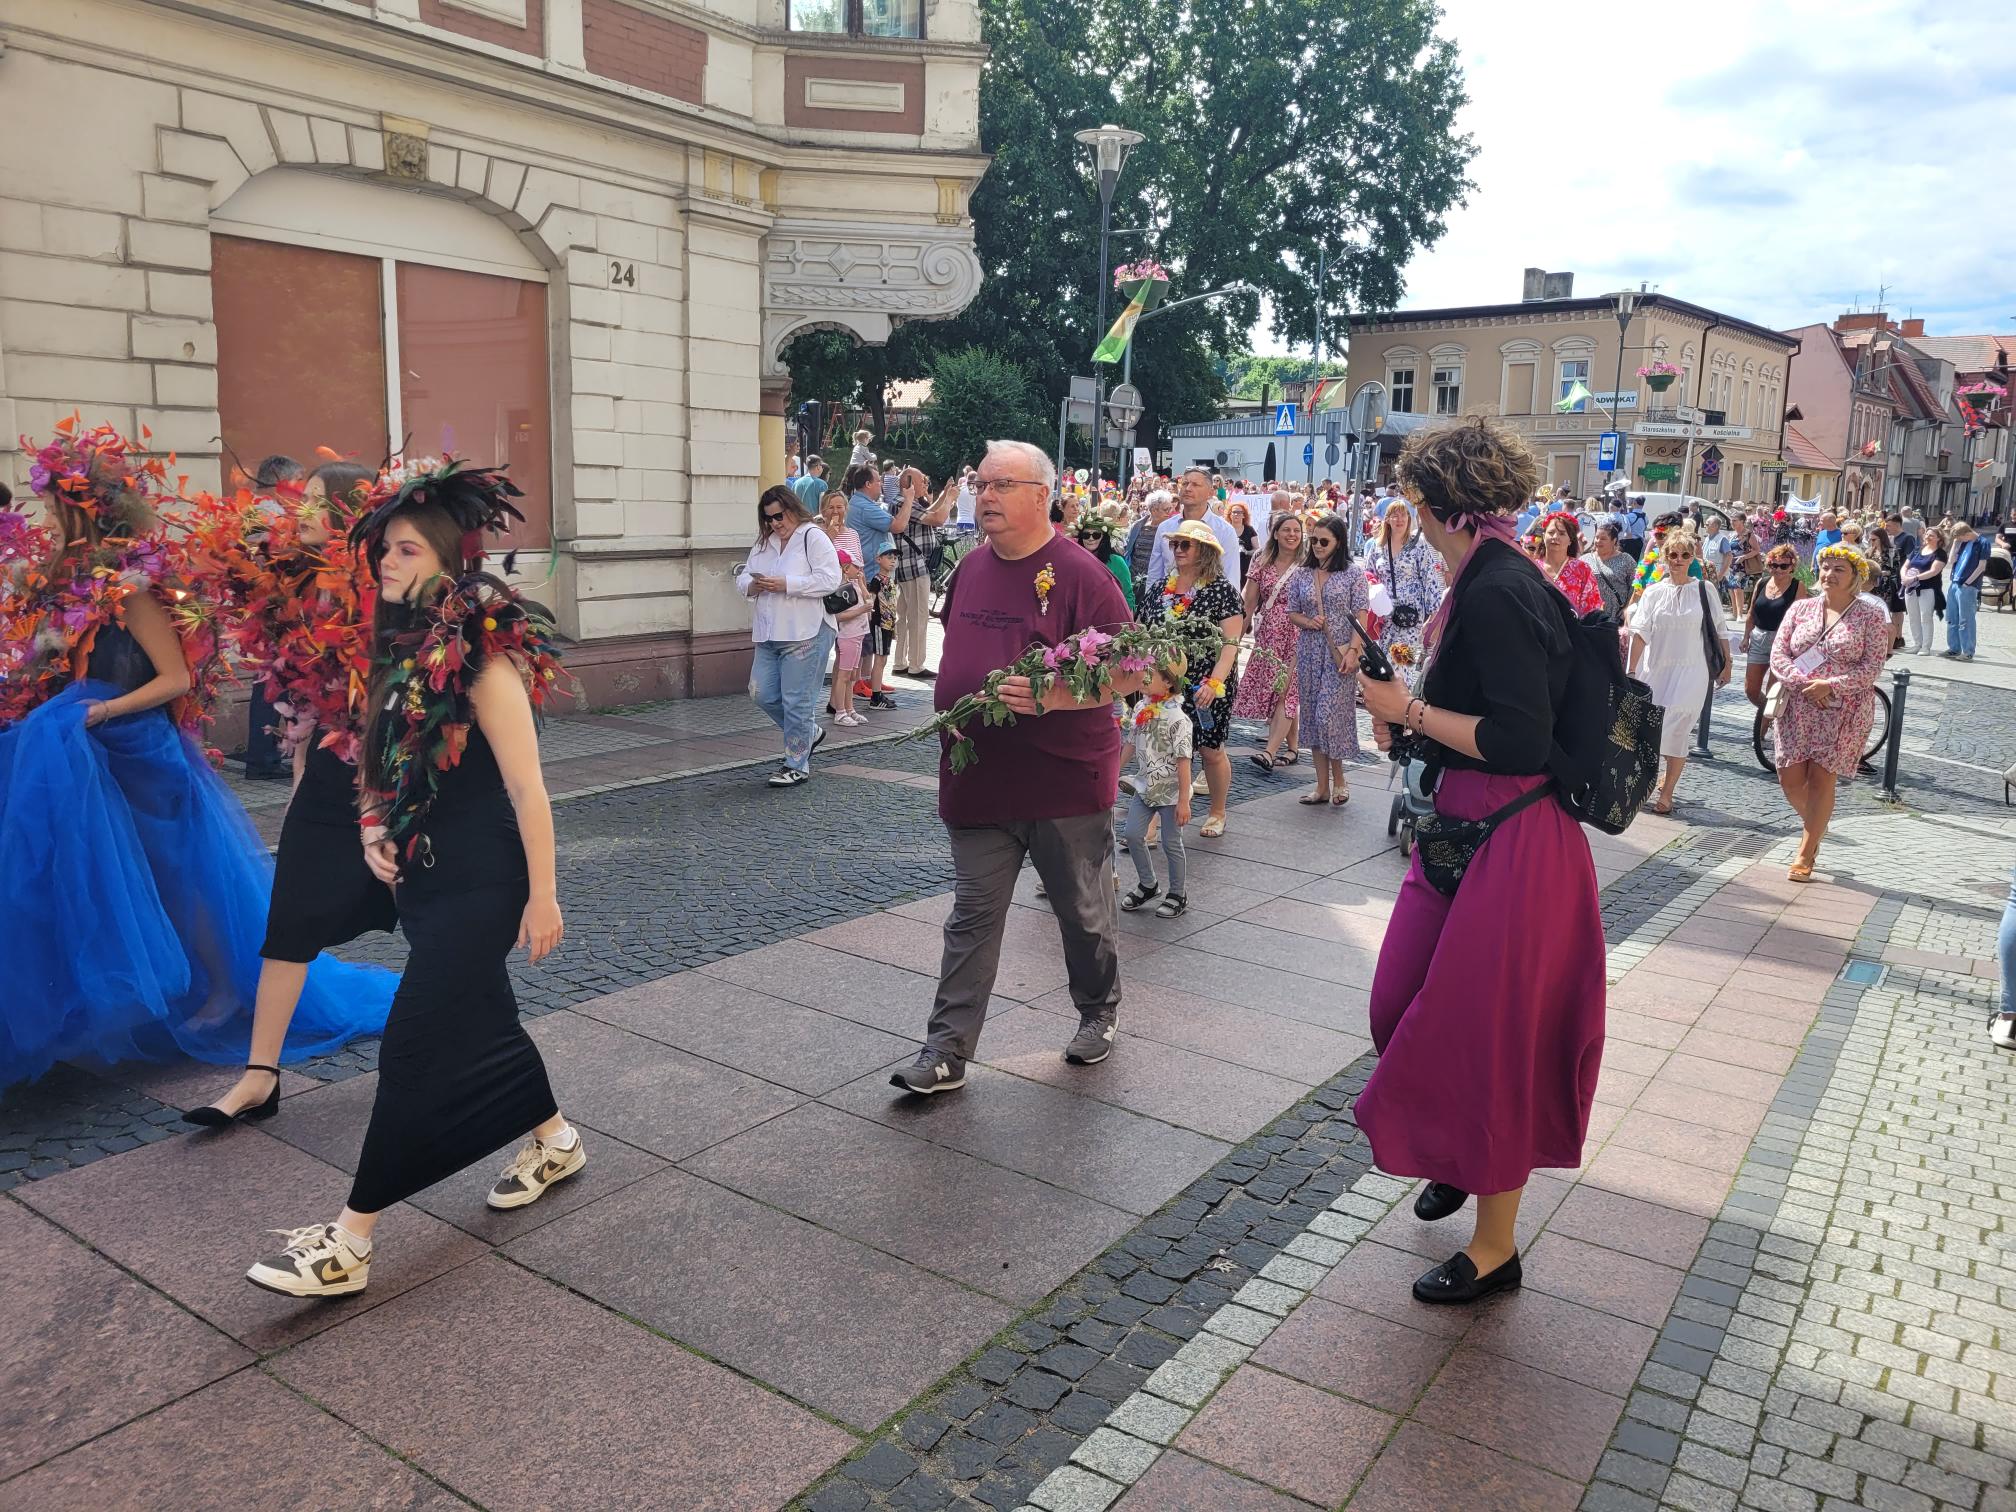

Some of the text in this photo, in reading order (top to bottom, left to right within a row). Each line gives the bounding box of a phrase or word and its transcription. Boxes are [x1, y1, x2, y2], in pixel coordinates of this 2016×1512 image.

[611, 261, 635, 287] 24
[1641, 426, 1677, 434] Staroszkolna
[1713, 428, 1741, 437] Kościelna
